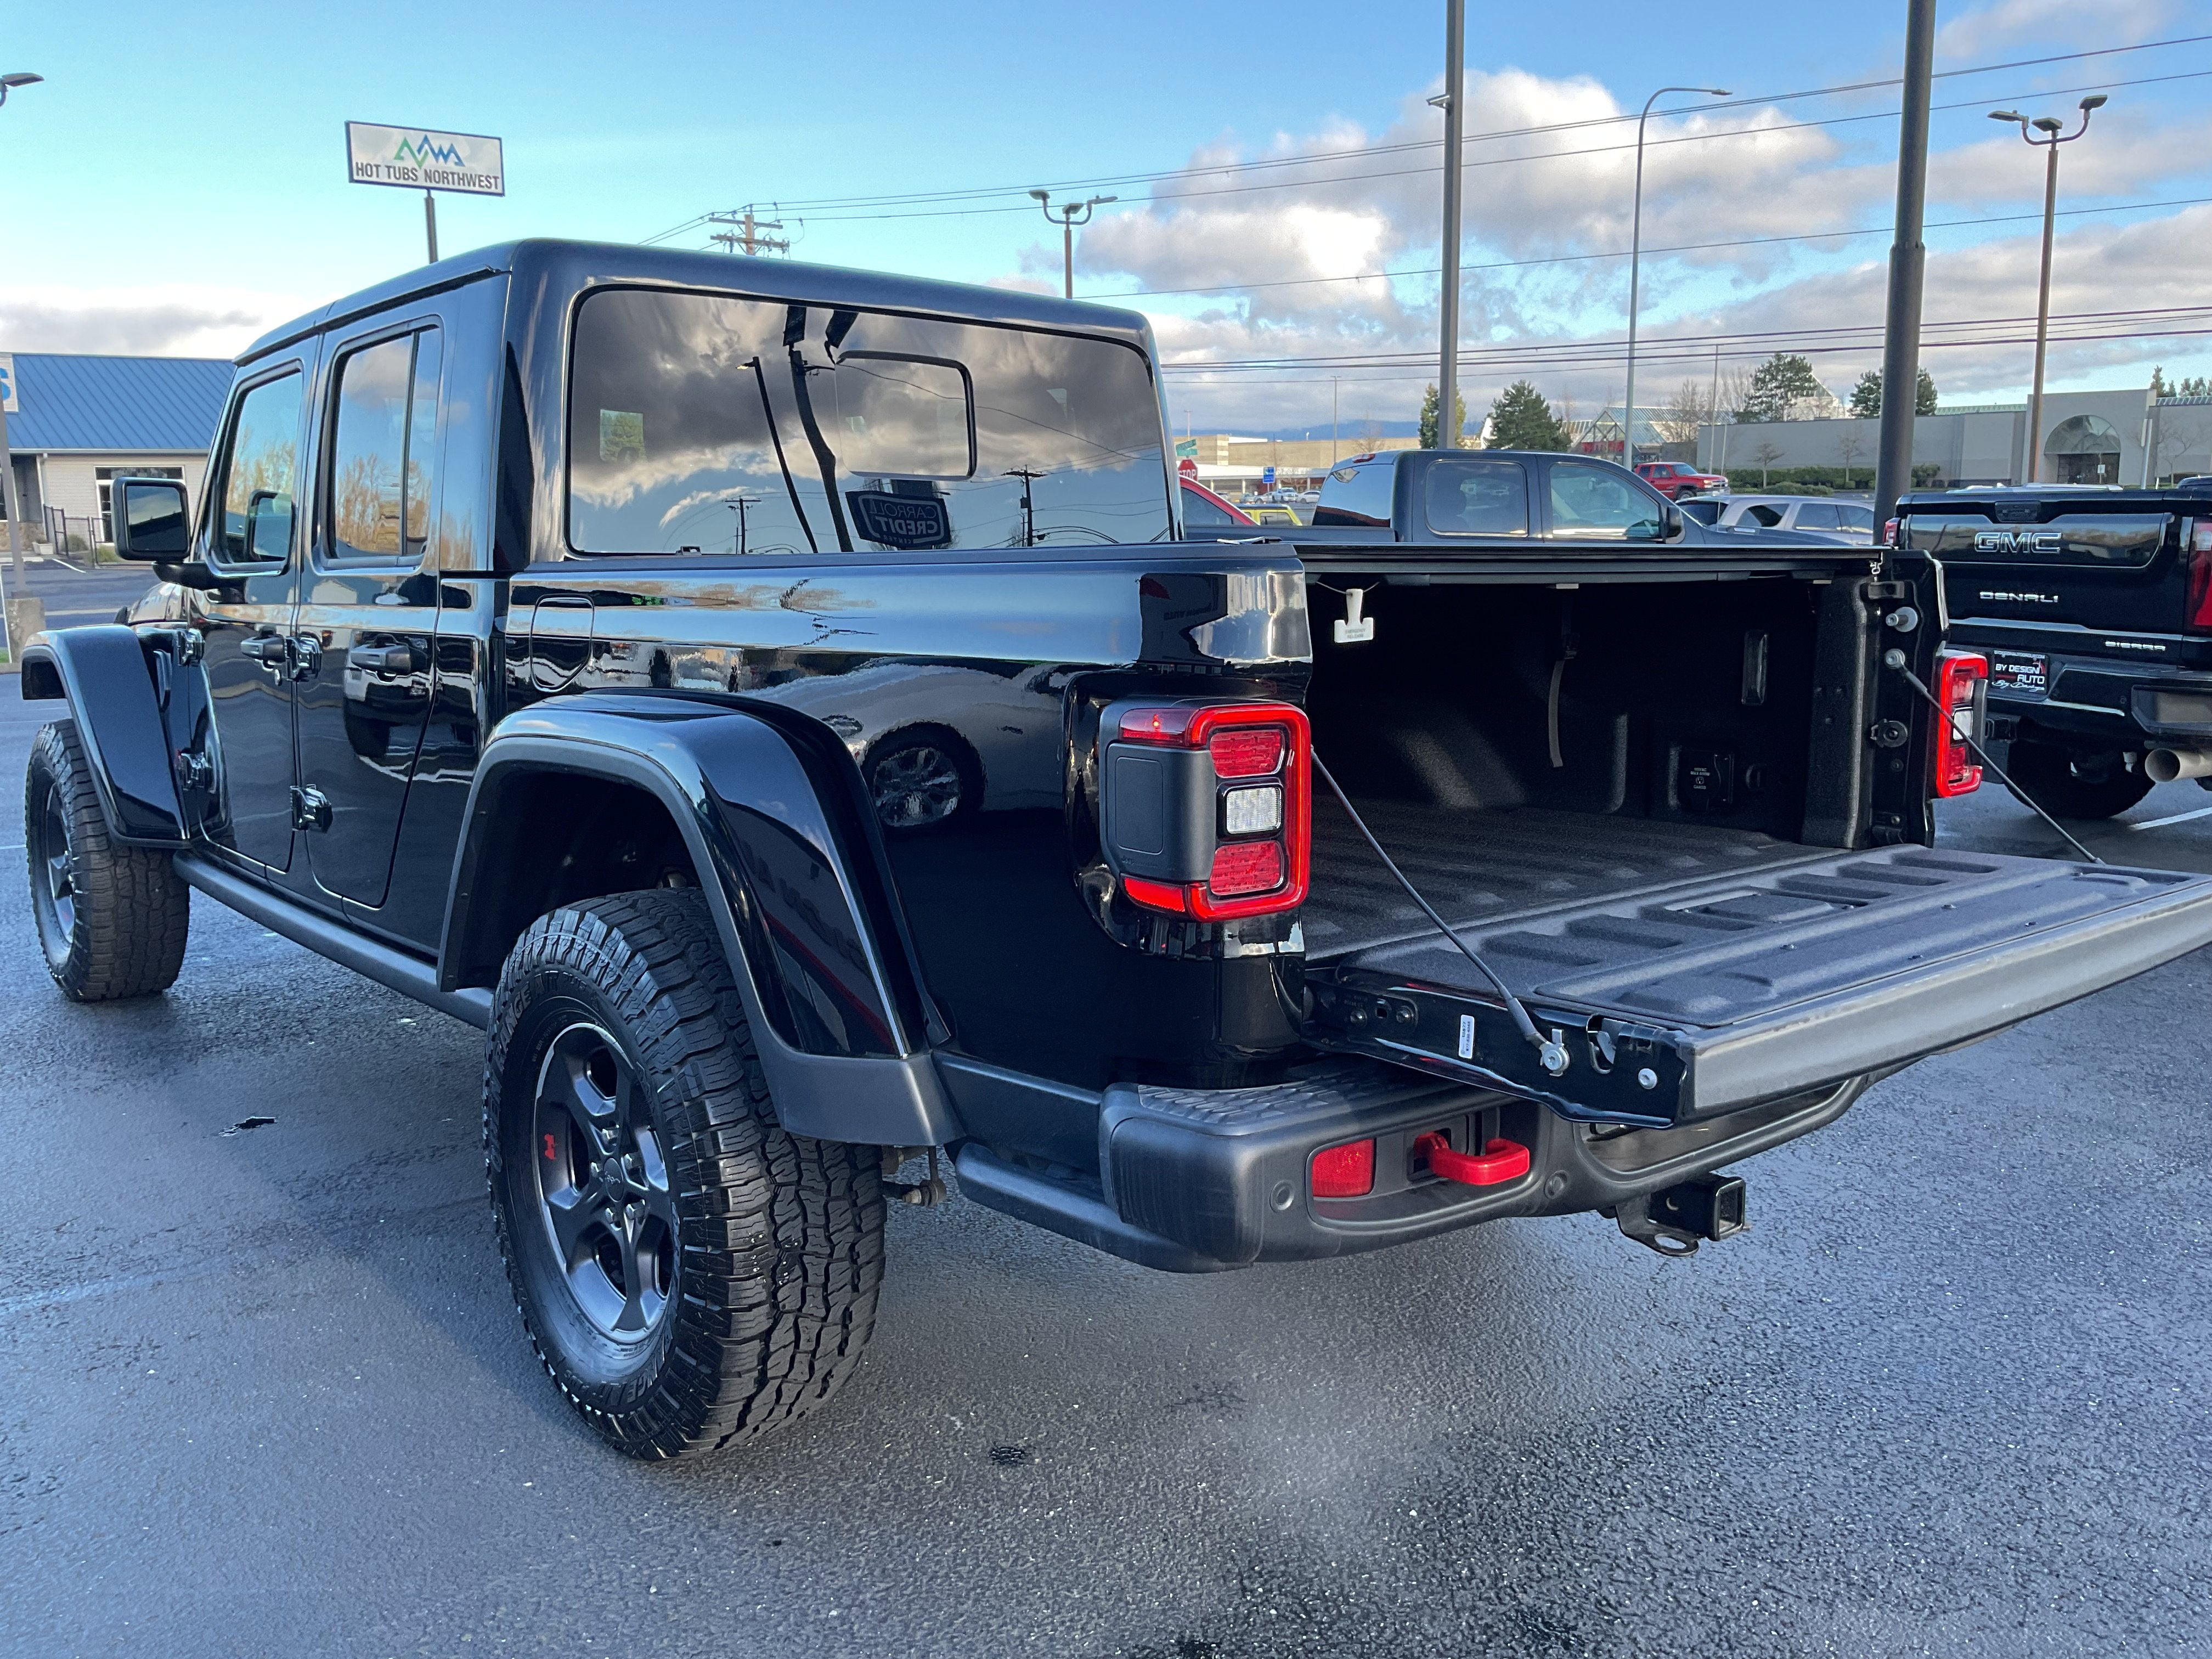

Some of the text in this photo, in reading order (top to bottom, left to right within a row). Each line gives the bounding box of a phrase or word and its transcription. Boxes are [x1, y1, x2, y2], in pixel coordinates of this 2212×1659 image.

[355, 161, 500, 190] HOT TUBS NORTHWEST
[1974, 532, 2062, 555] GMC
[1979, 591, 2058, 603] DENALI
[2104, 640, 2166, 651] SIERRA
[2008, 664, 2040, 674] DESIGN
[2017, 674, 2045, 684] AUTO
[493, 980, 534, 1076] RANGE
